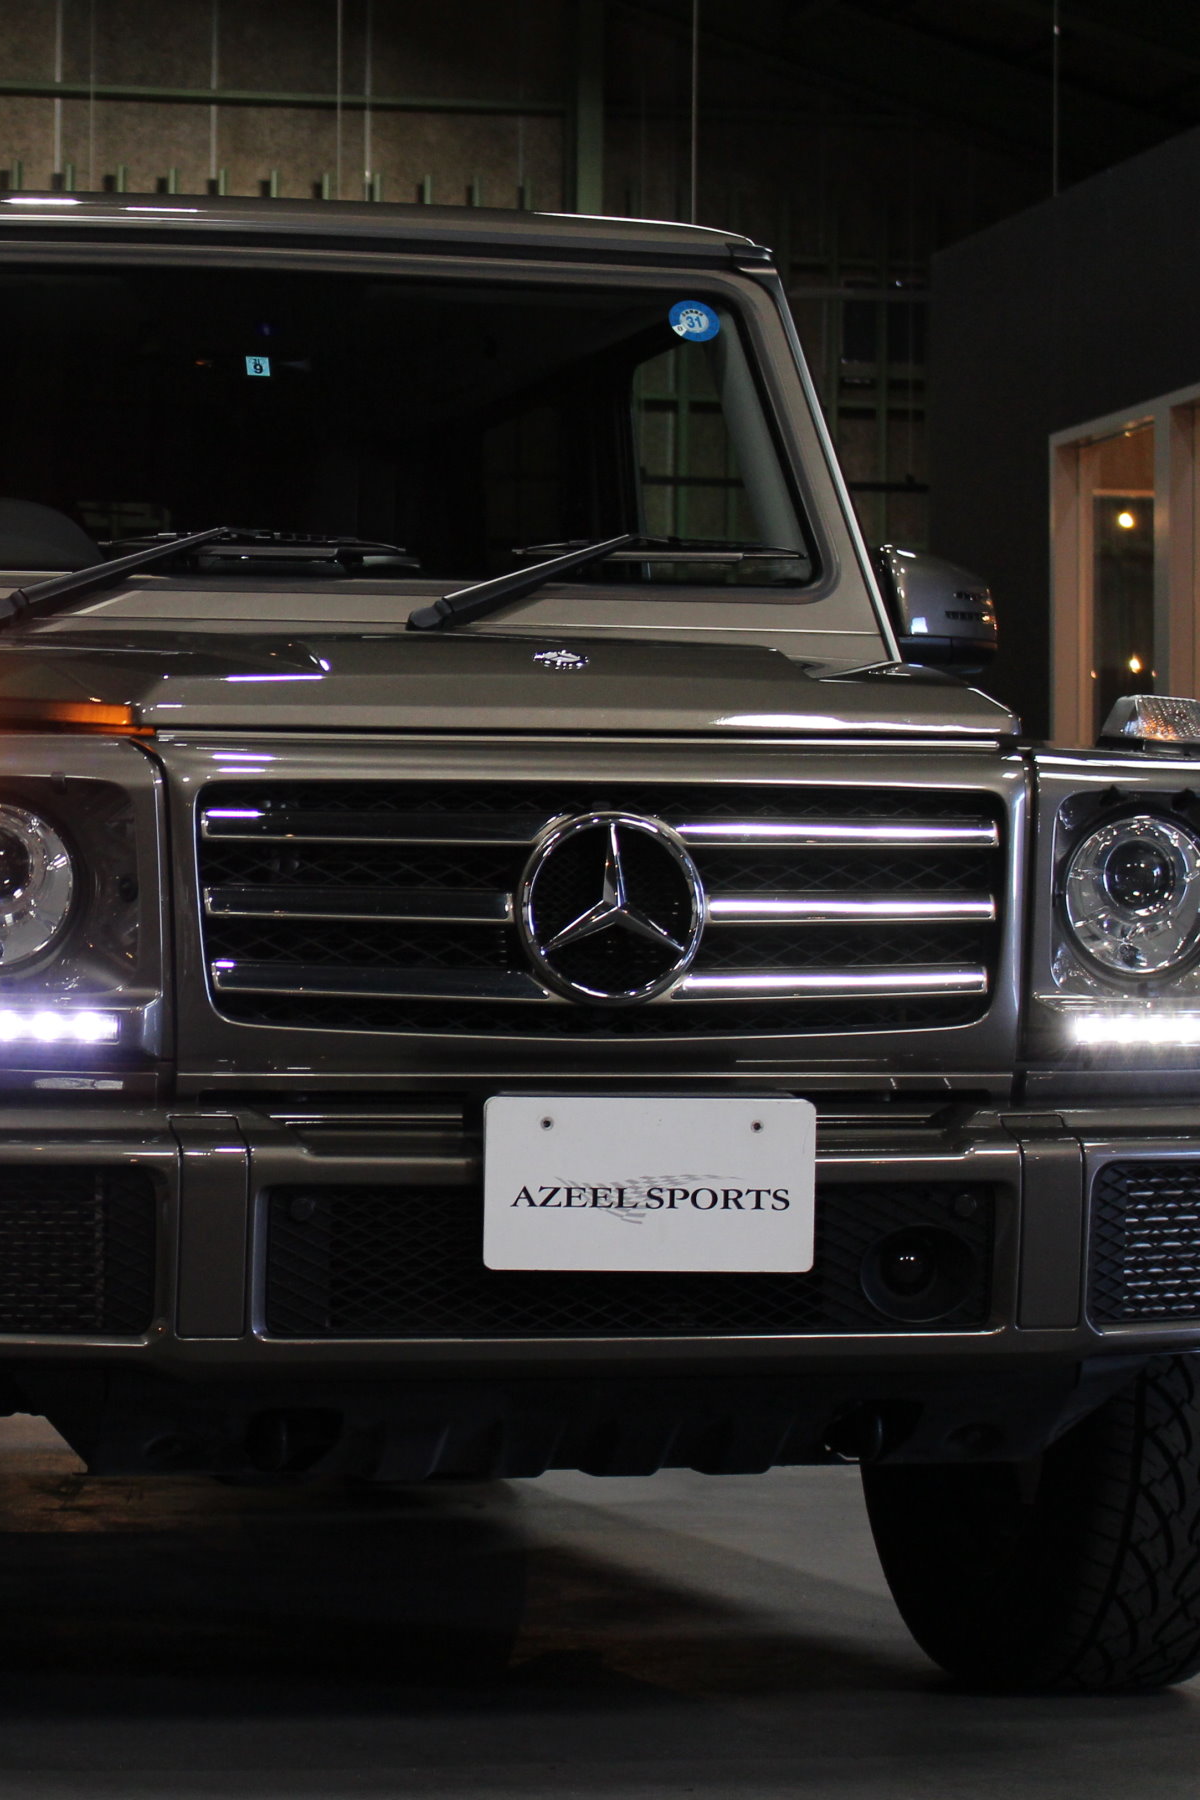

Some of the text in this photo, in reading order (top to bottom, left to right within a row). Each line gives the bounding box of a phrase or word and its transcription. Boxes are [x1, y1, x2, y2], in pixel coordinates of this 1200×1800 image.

[686, 316, 702, 328] 31
[253, 364, 263, 374] 9
[511, 1185, 790, 1211] AZEEL SPORTS
